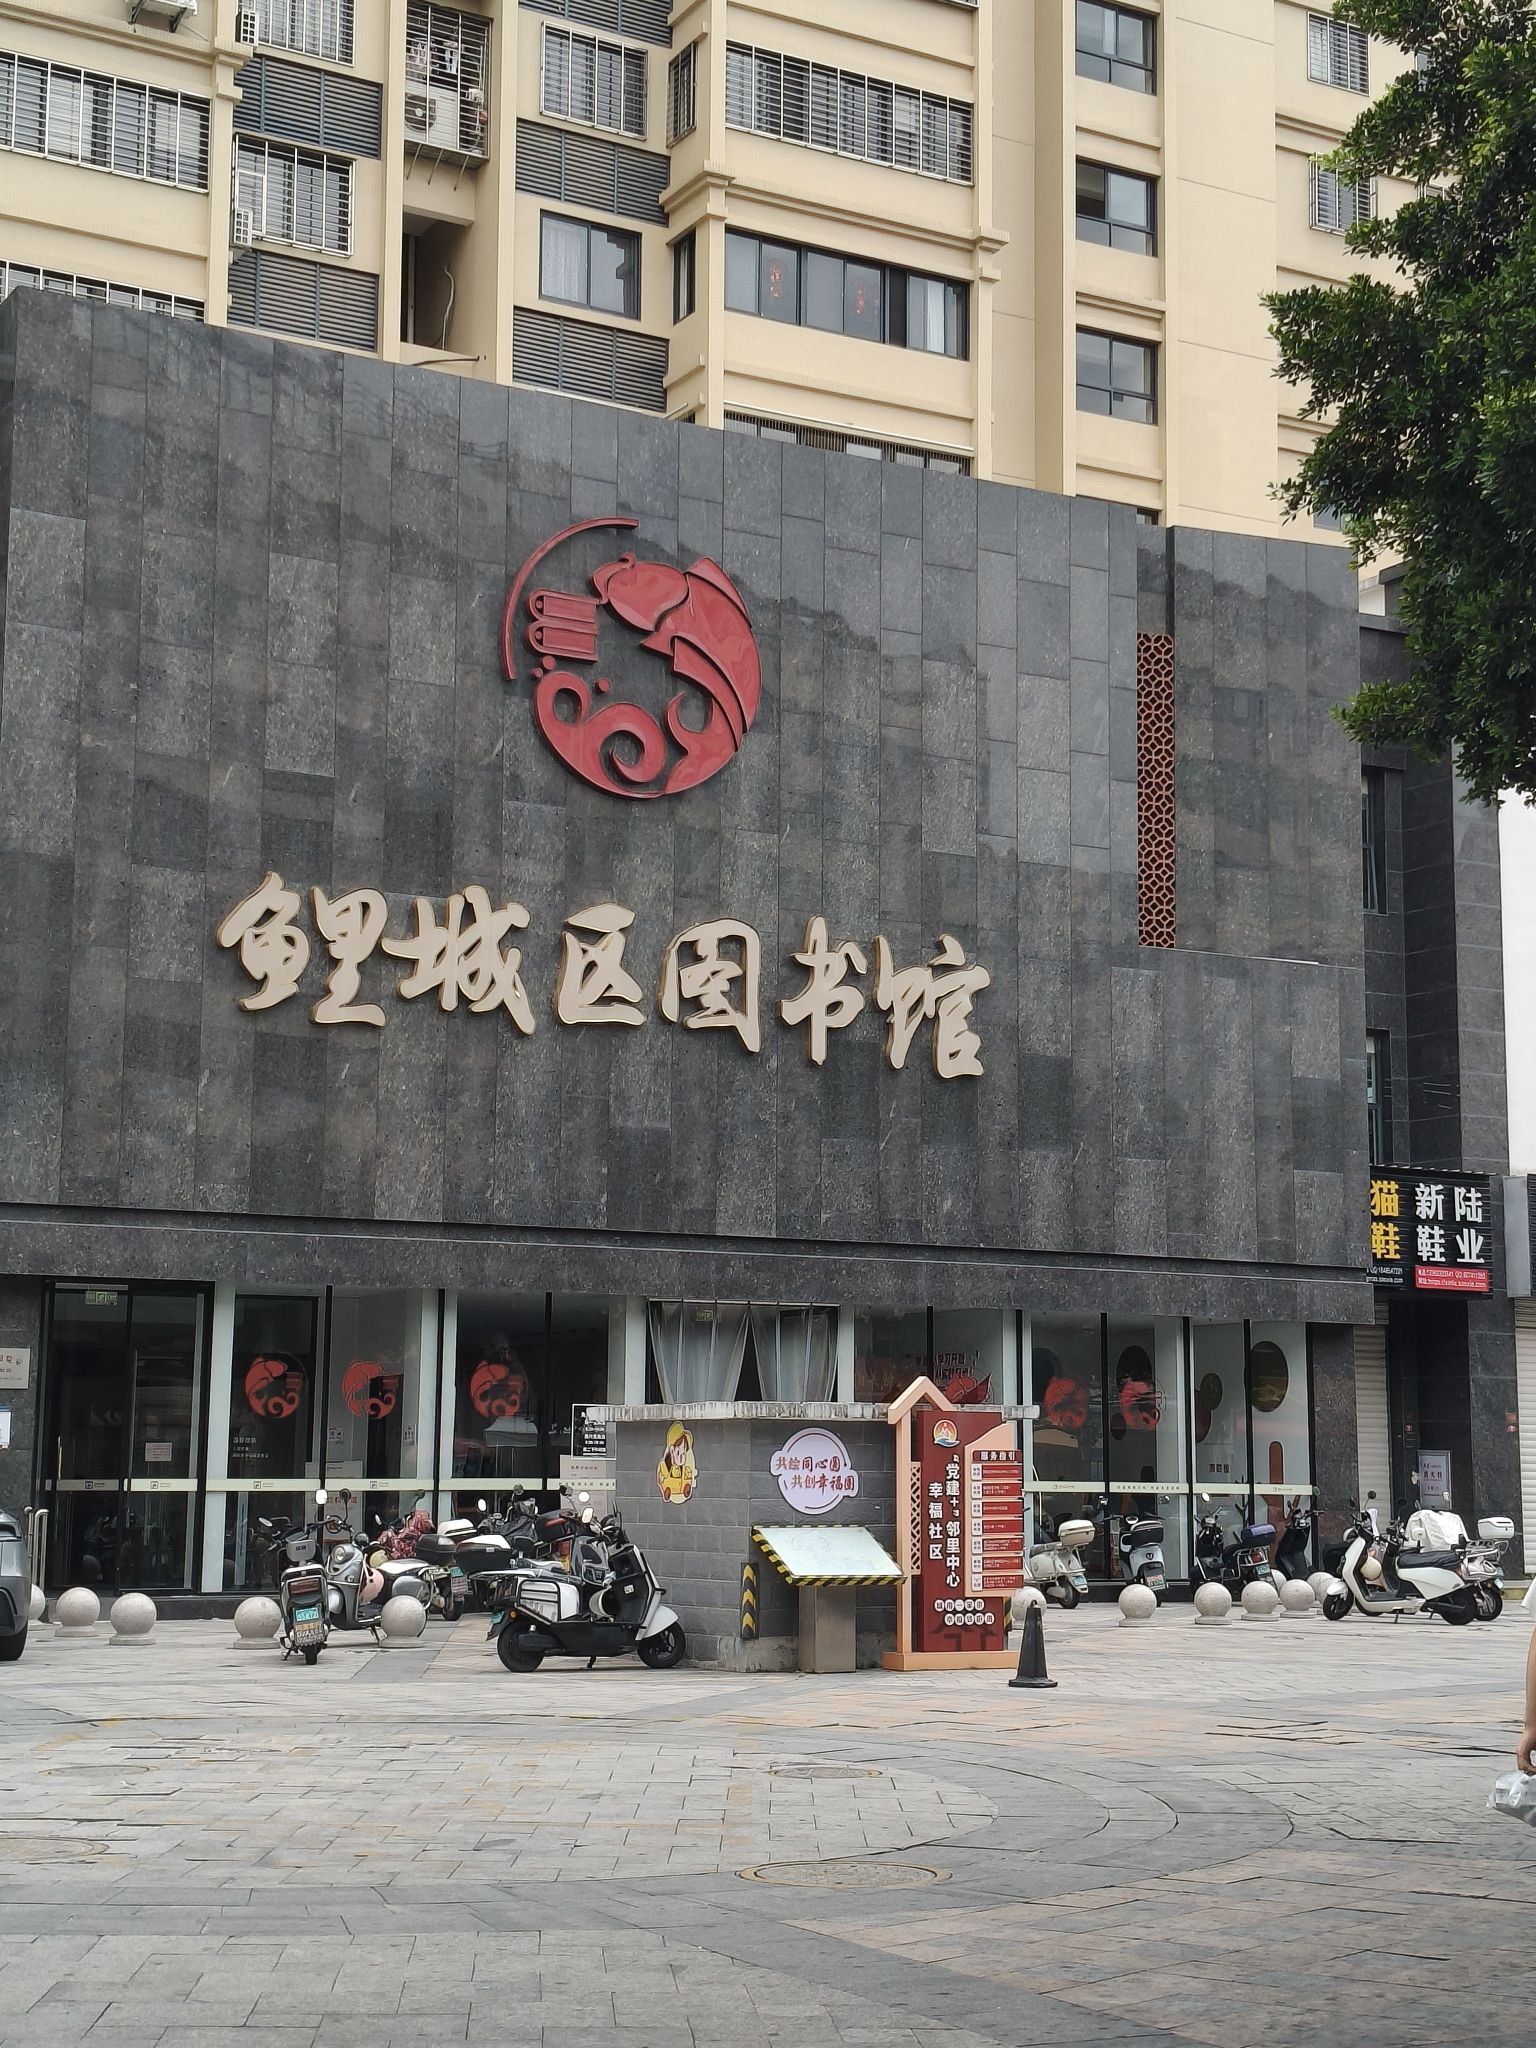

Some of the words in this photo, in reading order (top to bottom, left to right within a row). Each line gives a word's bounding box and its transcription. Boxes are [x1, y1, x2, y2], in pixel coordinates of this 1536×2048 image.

[218, 870, 992, 1079] 鲤城区图书馆
[1371, 1180, 1400, 1217] 猫
[1415, 1183, 1483, 1223] 新陆
[1371, 1221, 1401, 1259] 鞋
[1416, 1224, 1485, 1264] 鞋业
[928, 1482, 944, 1560] 幸福社区
